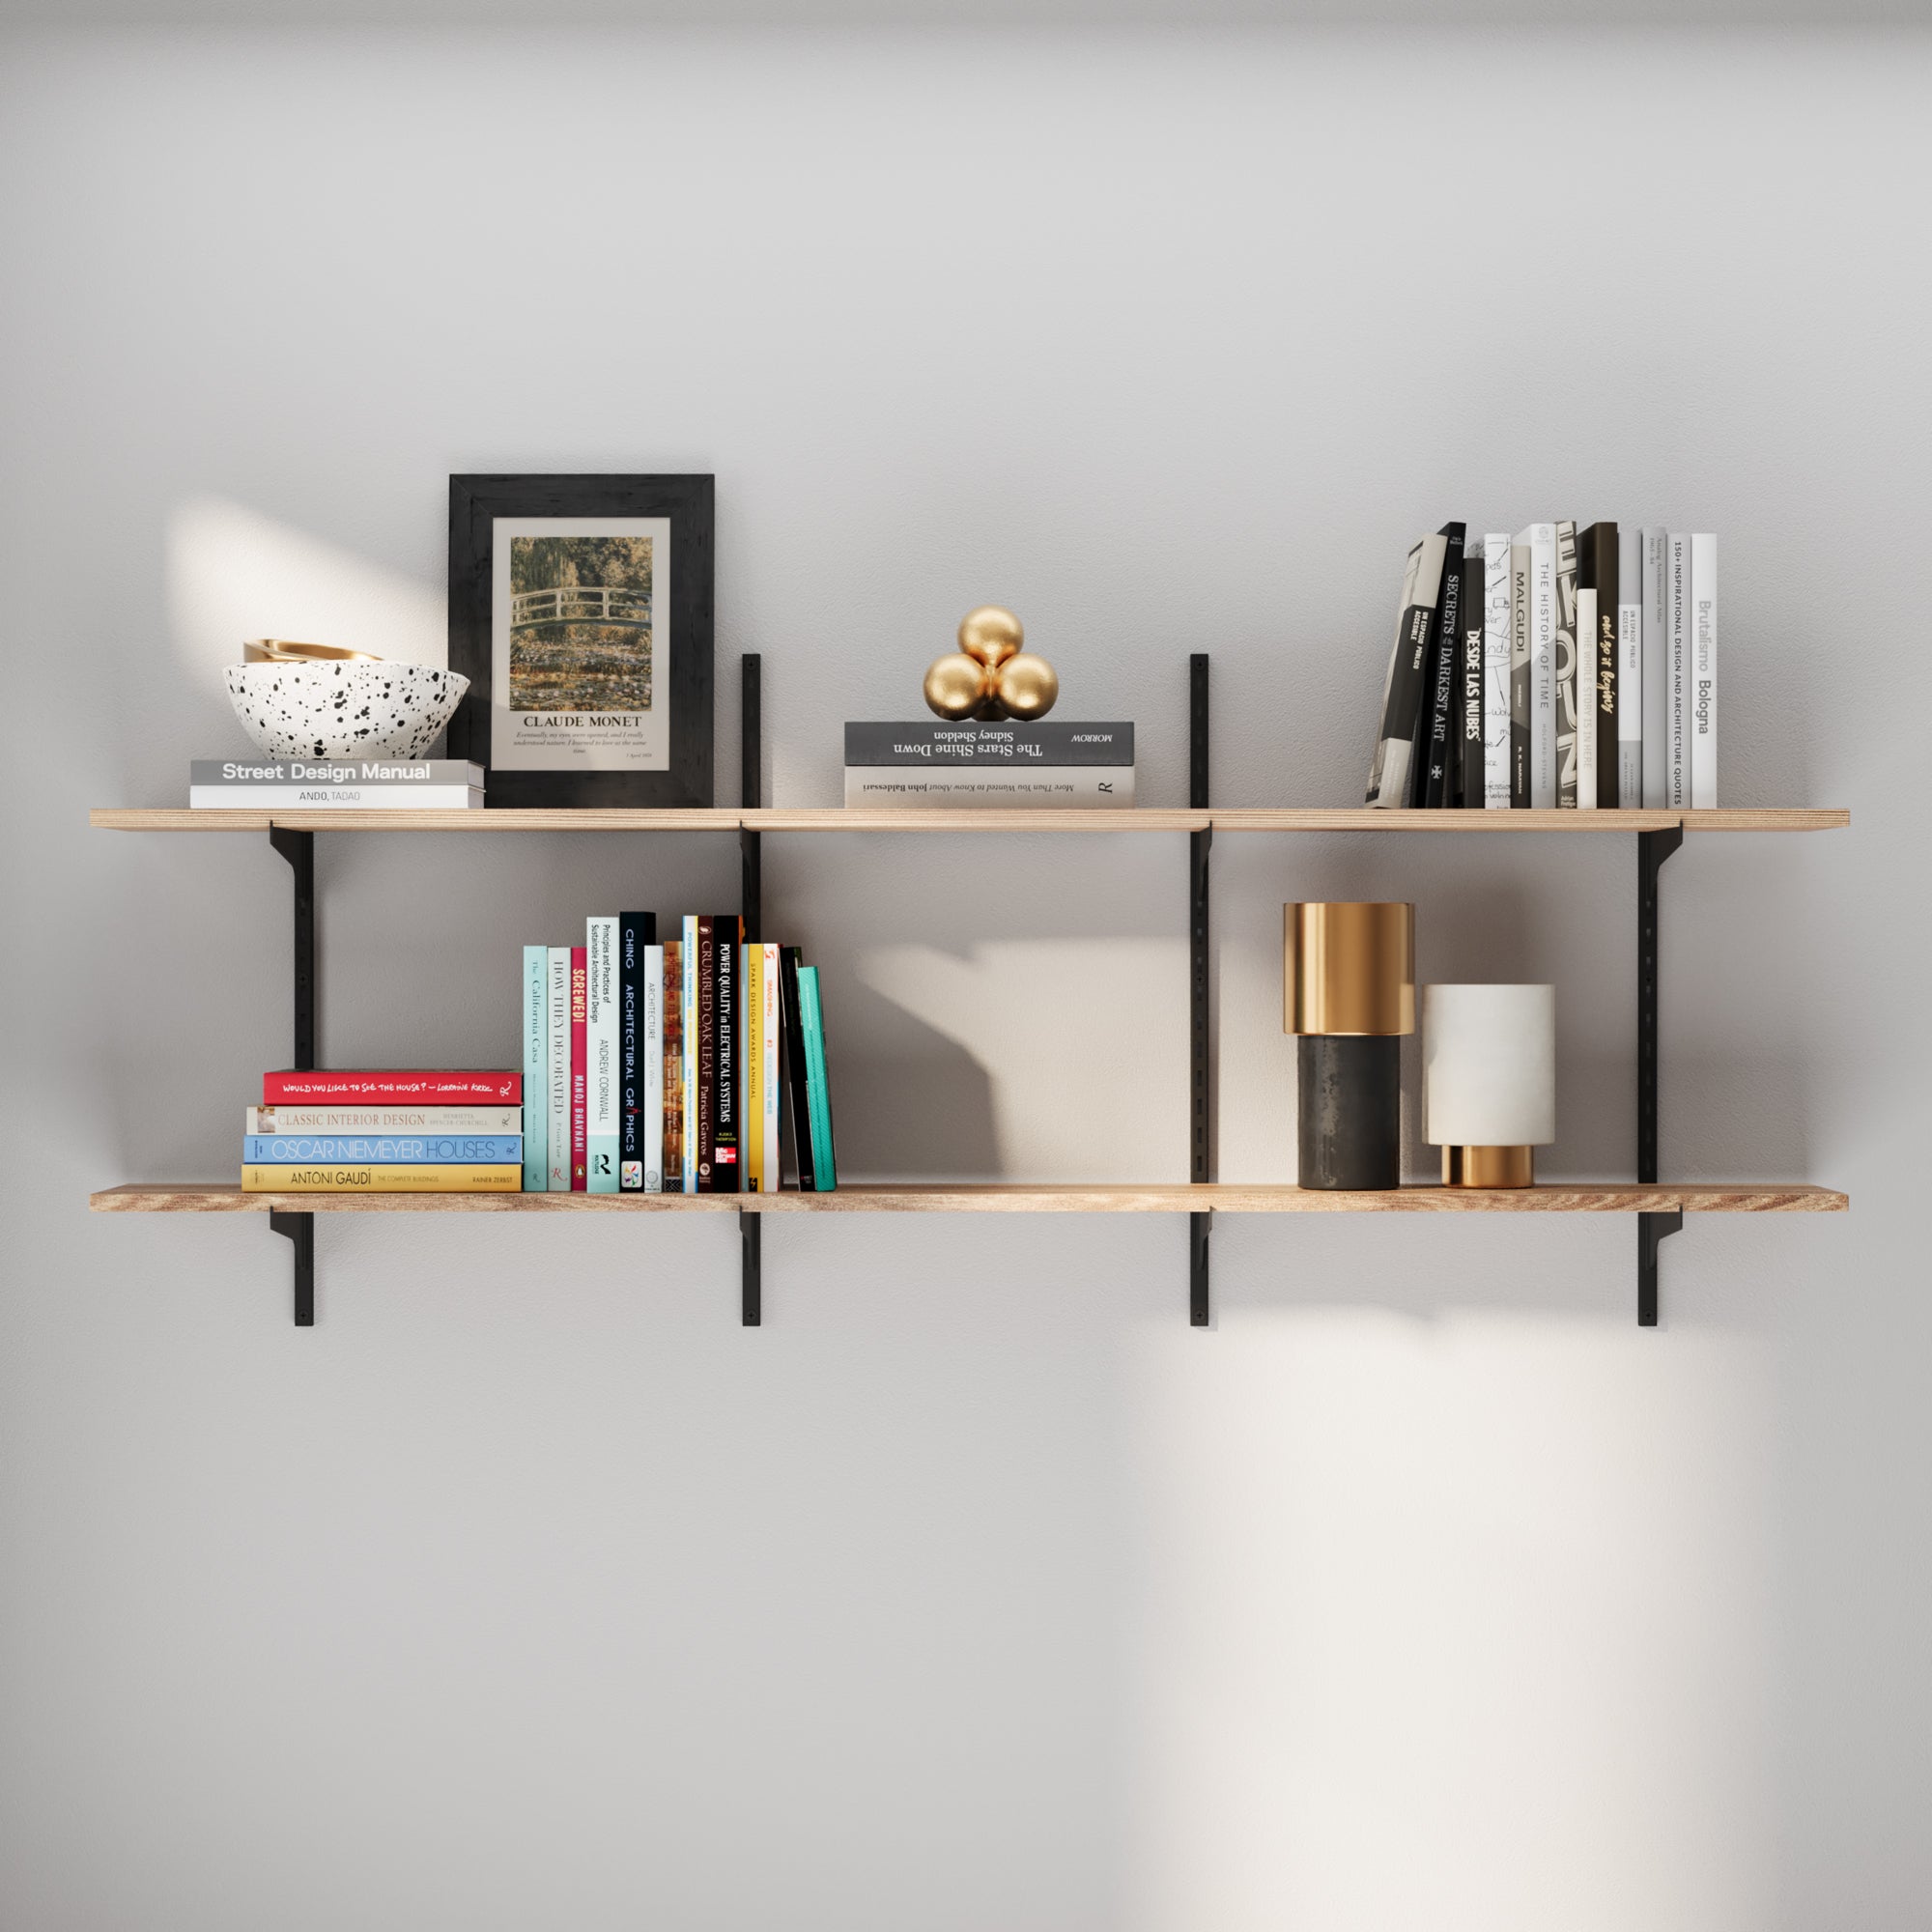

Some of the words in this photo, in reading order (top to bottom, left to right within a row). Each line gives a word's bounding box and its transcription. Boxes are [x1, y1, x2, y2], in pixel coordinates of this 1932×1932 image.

[1540, 563, 1548, 587] THE
[1421, 611, 1429, 620] UN
[1443, 574, 1460, 635] SECRETS
[1516, 572, 1524, 652] MALGUDI
[1630, 611, 1635, 619] UN
[1410, 610, 1421, 640] ACCESIBLE
[1417, 621, 1427, 644] ESPACIO
[1540, 594, 1548, 649] HISTORY
[1602, 614, 1615, 639] and
[1583, 631, 1592, 649] THE
[1698, 600, 1711, 672] Brutalismo
[1540, 655, 1548, 671] OF
[1583, 651, 1592, 683] WHOLE
[1601, 657, 1612, 668] it
[1436, 647, 1452, 711] DARKEST
[1466, 673, 1480, 696] LAS
[1540, 677, 1548, 709] TIME
[1596, 670, 1615, 714] begins
[1583, 687, 1592, 716] STORY
[1696, 679, 1711, 734] Bologna
[524, 716, 584, 727] CLAUDE
[589, 716, 642, 727] MONET
[1434, 713, 1446, 742] ART
[1583, 718, 1592, 726] IS
[894, 744, 931, 756] Down
[933, 731, 977, 742] Sheldon
[934, 744, 974, 756] Shine
[977, 744, 1013, 756] Stars
[978, 731, 1014, 742] Sidney
[1016, 744, 1043, 756] The
[1583, 731, 1592, 742] IN
[1583, 745, 1592, 769] HERE
[222, 763, 284, 780] Street
[291, 763, 356, 782] Design
[361, 763, 431, 780] Manual
[1673, 767, 1682, 805] QUOTES
[299, 791, 329, 802] ANDO,
[331, 791, 360, 801] TADAO
[863, 783, 906, 792] Baldessari
[907, 783, 927, 792] John
[929, 783, 951, 792] About
[951, 783, 975, 792] Know
[986, 783, 1015, 792] Wanted
[590, 924, 599, 958] Sustainable
[602, 924, 611, 953] Principles
[603, 954, 611, 966] and
[721, 944, 730, 974] POWER
[554, 961, 564, 991] HOW
[590, 960, 599, 1000] Architectural
[603, 967, 611, 995] Practices
[701, 941, 712, 1011] CRUMBLED
[532, 980, 542, 1035] California
[573, 968, 585, 1023] SCREWED!
[719, 975, 730, 1014] QUALITY
[554, 997, 564, 1029] THEY
[590, 1002, 599, 1024] Design
[701, 1013, 712, 1043] OAK
[532, 1037, 542, 1064] Casa
[599, 1039, 610, 1074] ANDREW
[702, 1046, 712, 1078] LEAF
[721, 1025, 730, 1080] ELECTRICAL
[283, 1084, 311, 1093] WOULD
[361, 1083, 377, 1093] SEE
[396, 1082, 427, 1092] HOUSE?
[554, 1035, 564, 1114] DECORATED
[574, 1075, 584, 1103] MANOJ
[599, 1076, 610, 1122] CORNWALL
[700, 1086, 709, 1120] Patricia
[721, 1082, 730, 1122] SYSTEMS
[277, 1114, 325, 1126] CLASSIC
[327, 1114, 381, 1126] INTERIOR
[384, 1114, 426, 1126] DESIGN
[574, 1108, 584, 1152] BHAVNANI
[626, 1088, 641, 1152] GRAPHICS
[271, 1140, 334, 1159] OSCAR
[338, 1140, 423, 1159] NIEMEYER
[426, 1140, 496, 1159] HOUSES
[700, 1122, 709, 1156] Gavros
[291, 1172, 333, 1185] ANTONI
[335, 1168, 372, 1185] GAUDÍ
